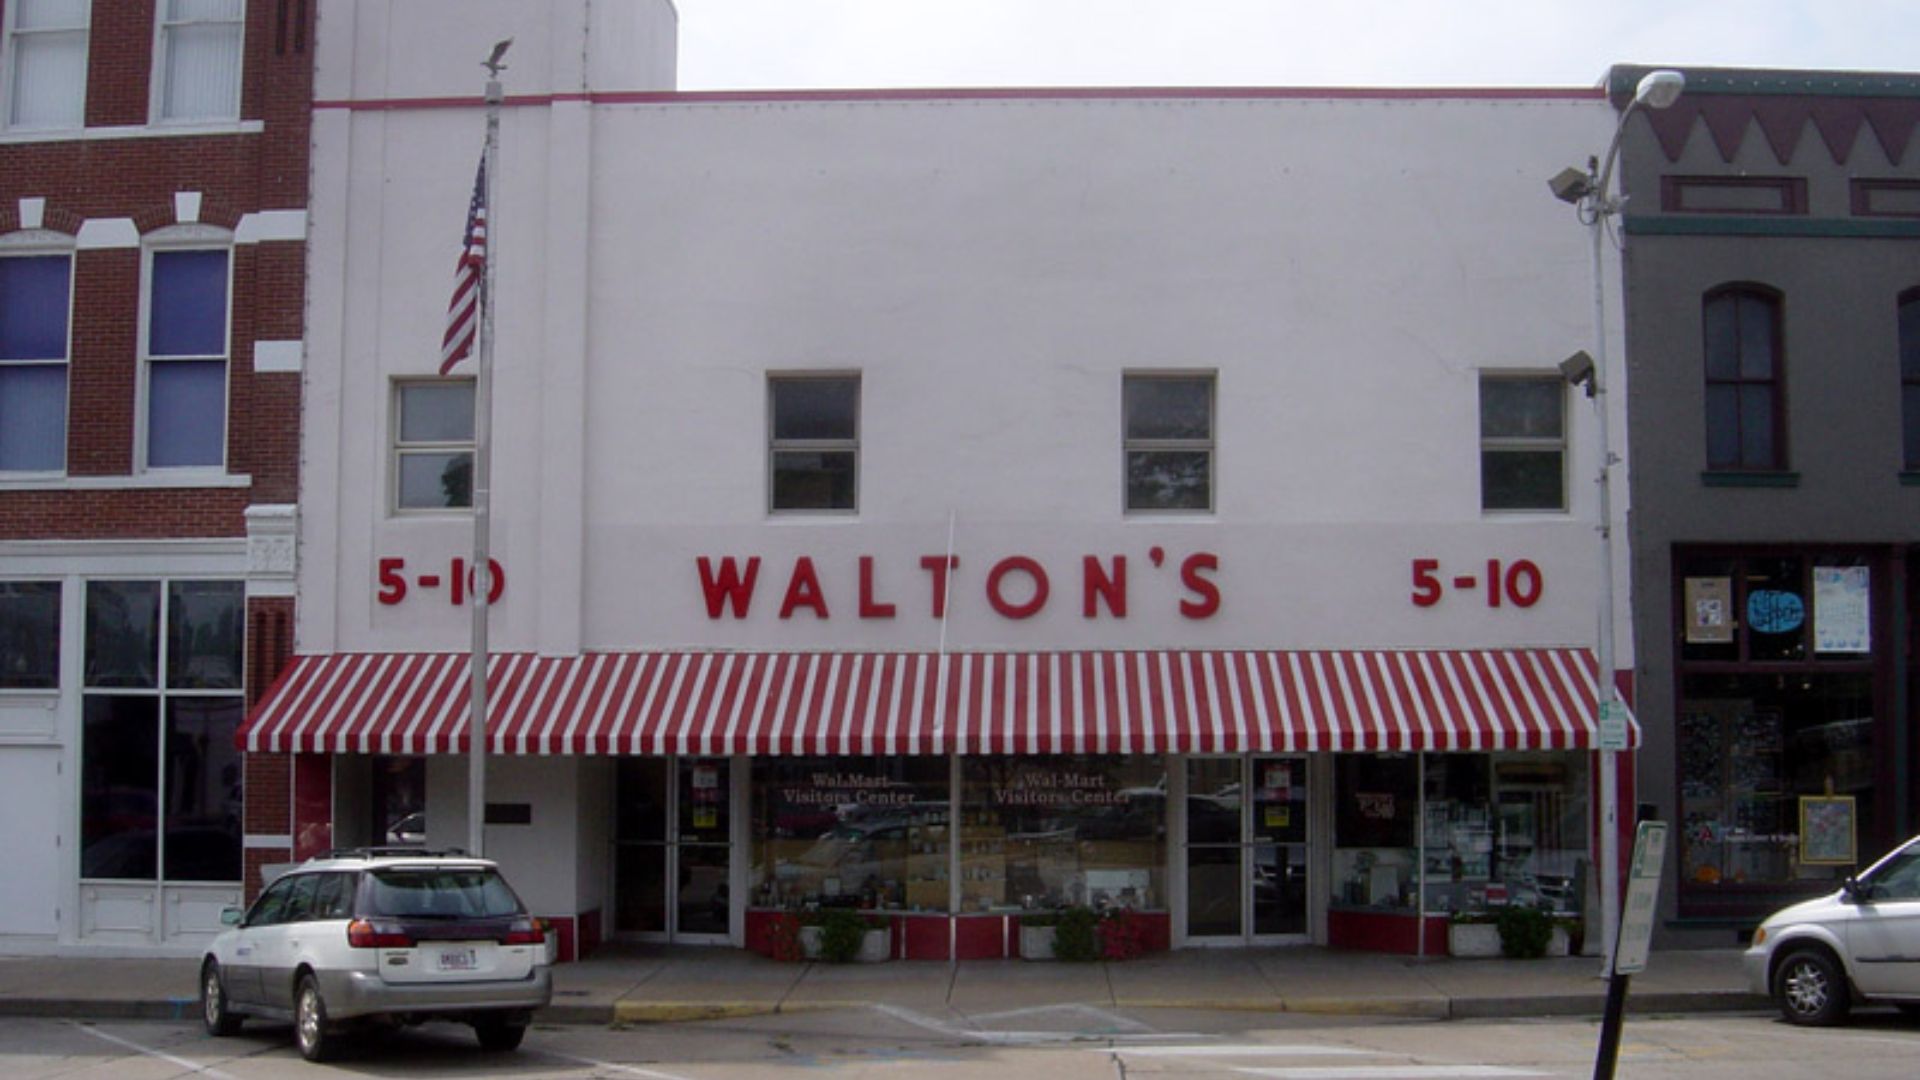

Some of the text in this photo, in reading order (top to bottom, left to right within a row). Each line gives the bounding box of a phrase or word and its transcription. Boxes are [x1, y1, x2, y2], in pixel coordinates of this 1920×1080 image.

[378, 557, 506, 606] 5-10
[696, 547, 1221, 619] WALTON'S
[1412, 558, 1543, 607] 5-10
[1025, 772, 1105, 788] Wal-Mart
[783, 789, 916, 804] Visitors Center
[995, 789, 1130, 805] Visitors Center
